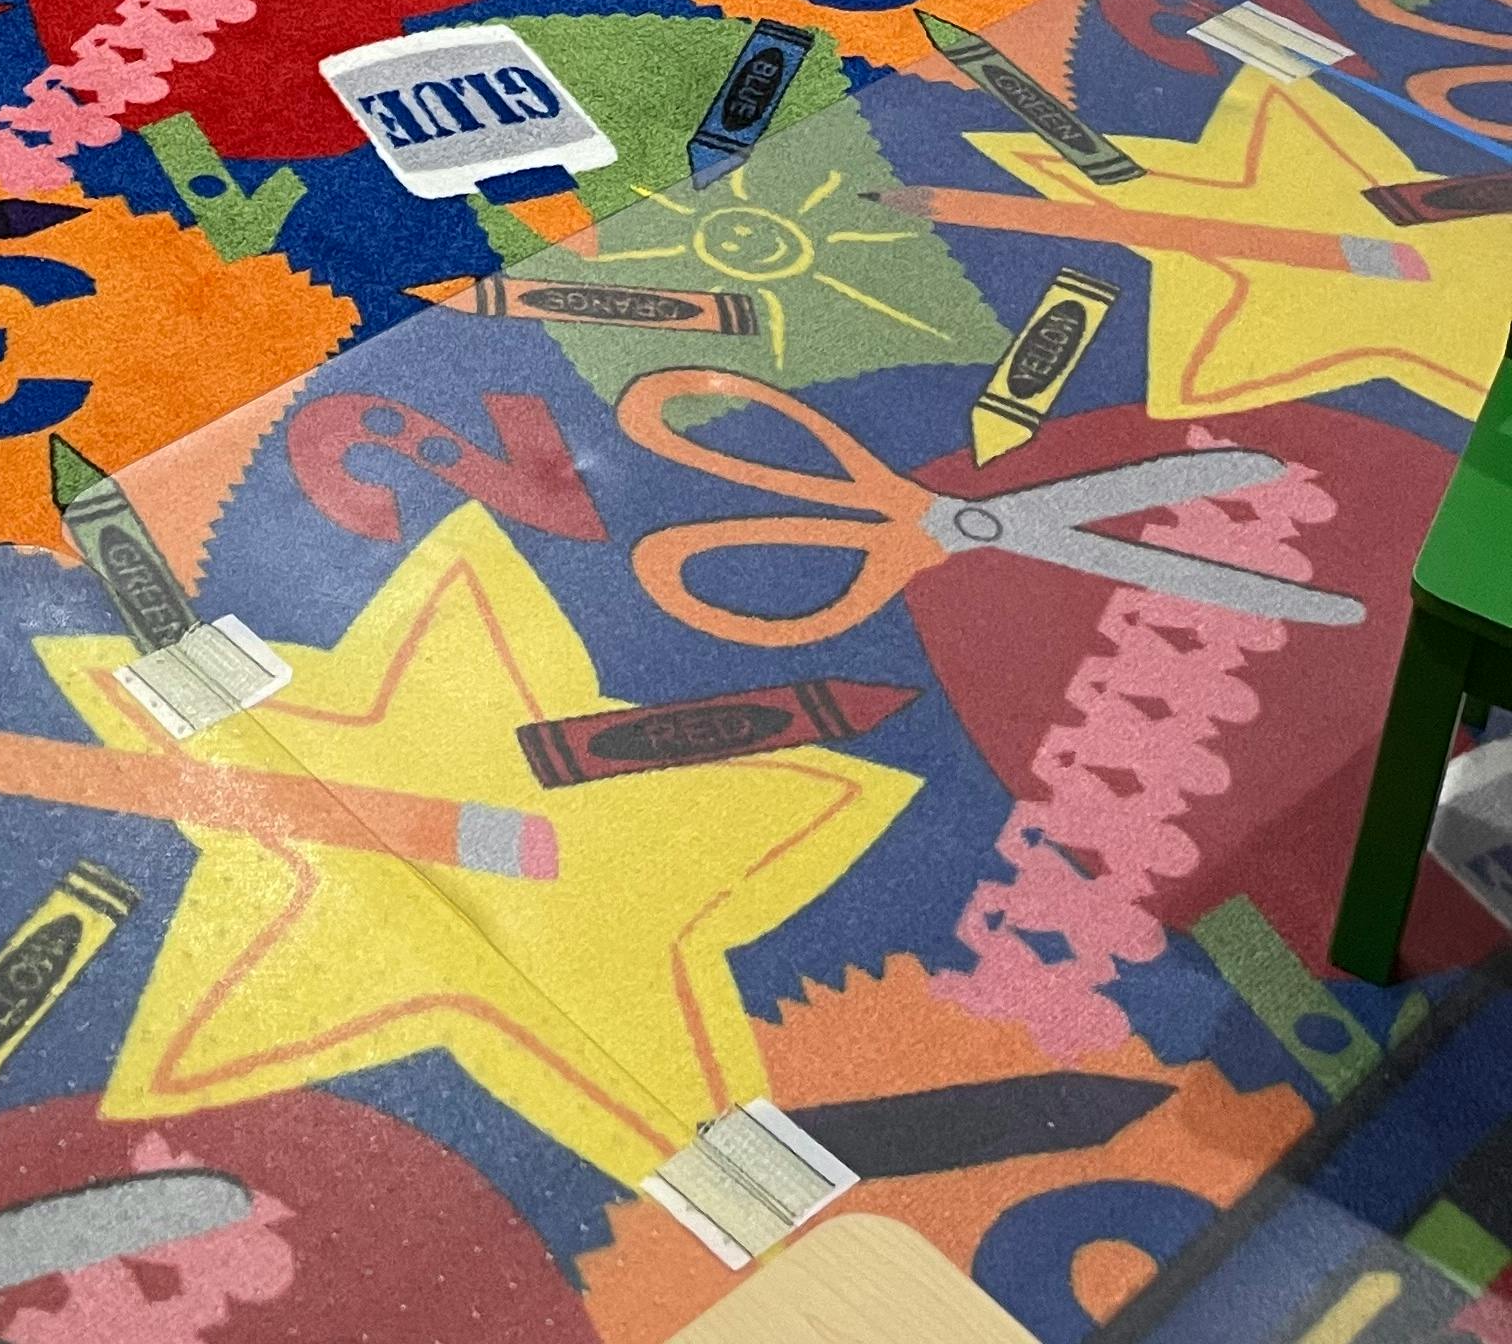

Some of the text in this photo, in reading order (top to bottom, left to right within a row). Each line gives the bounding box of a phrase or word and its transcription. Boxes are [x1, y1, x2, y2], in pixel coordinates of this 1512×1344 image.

[361, 66, 561, 149] GLUE
[731, 64, 777, 117] BLUE
[139, 112, 308, 263] 1
[291, 393, 608, 541] 2
